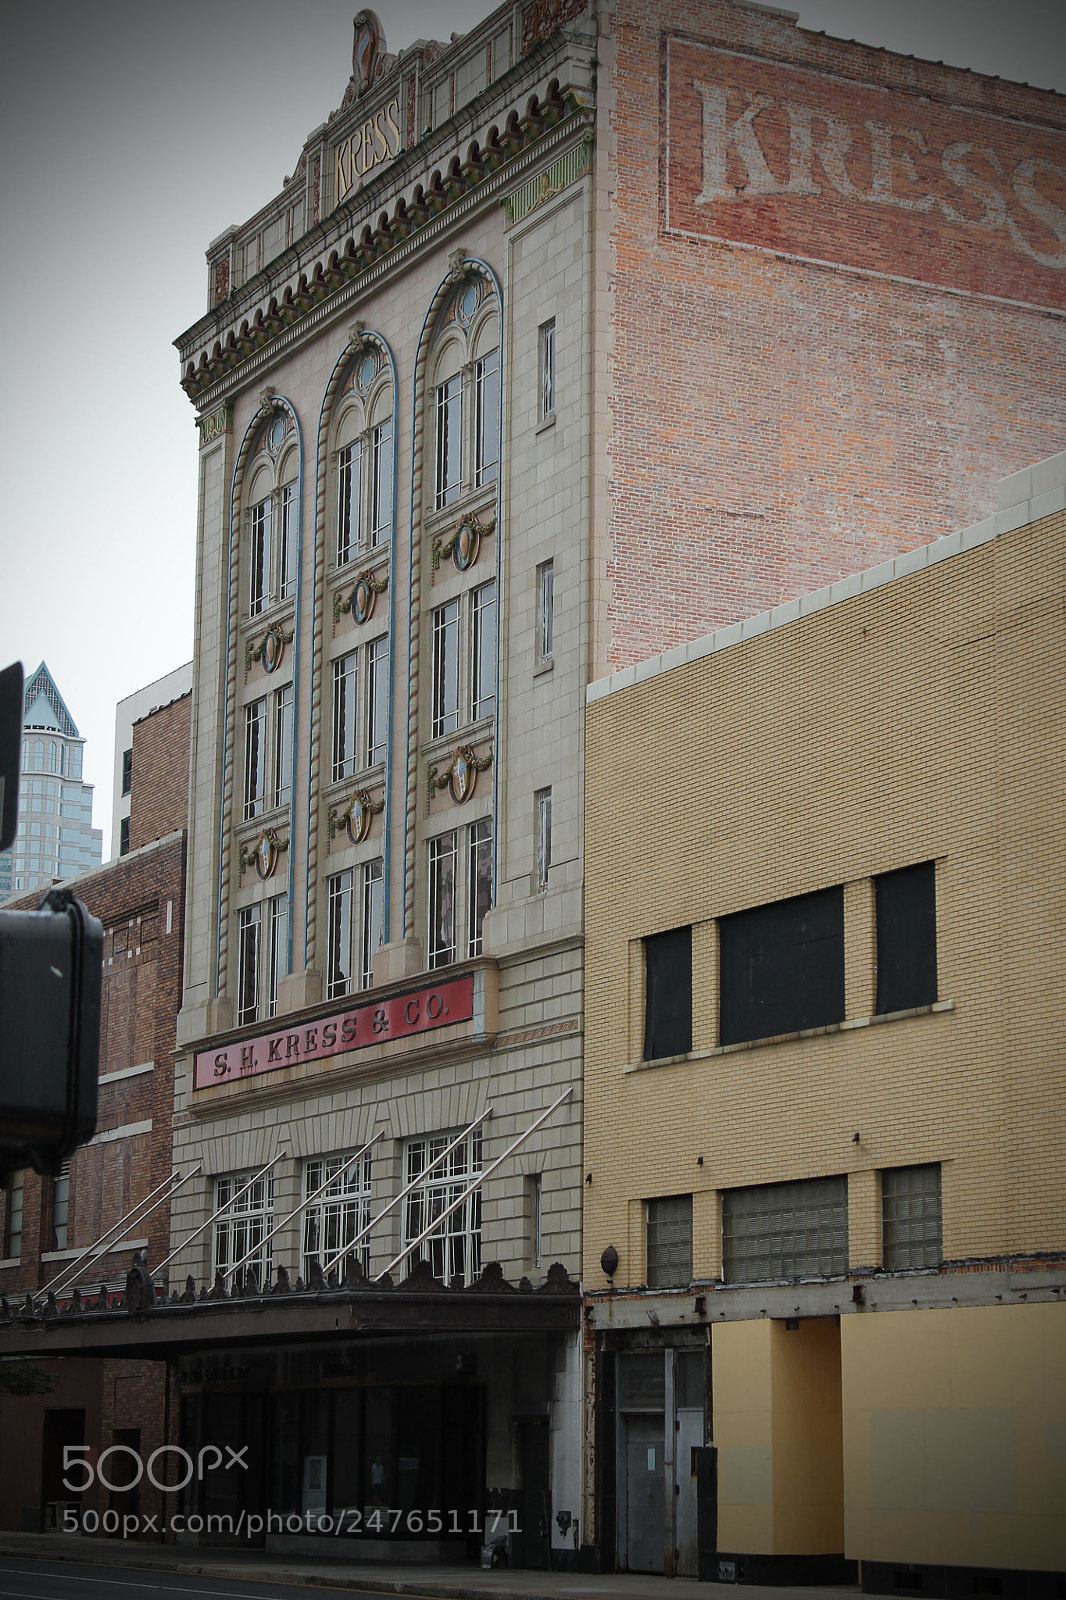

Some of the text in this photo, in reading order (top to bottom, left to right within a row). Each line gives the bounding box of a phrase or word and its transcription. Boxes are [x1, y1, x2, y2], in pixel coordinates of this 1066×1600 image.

[333, 97, 400, 210] KRESS
[694, 80, 1066, 270] KRESS
[213, 993, 449, 1076] S. H. KRESS & CO.
